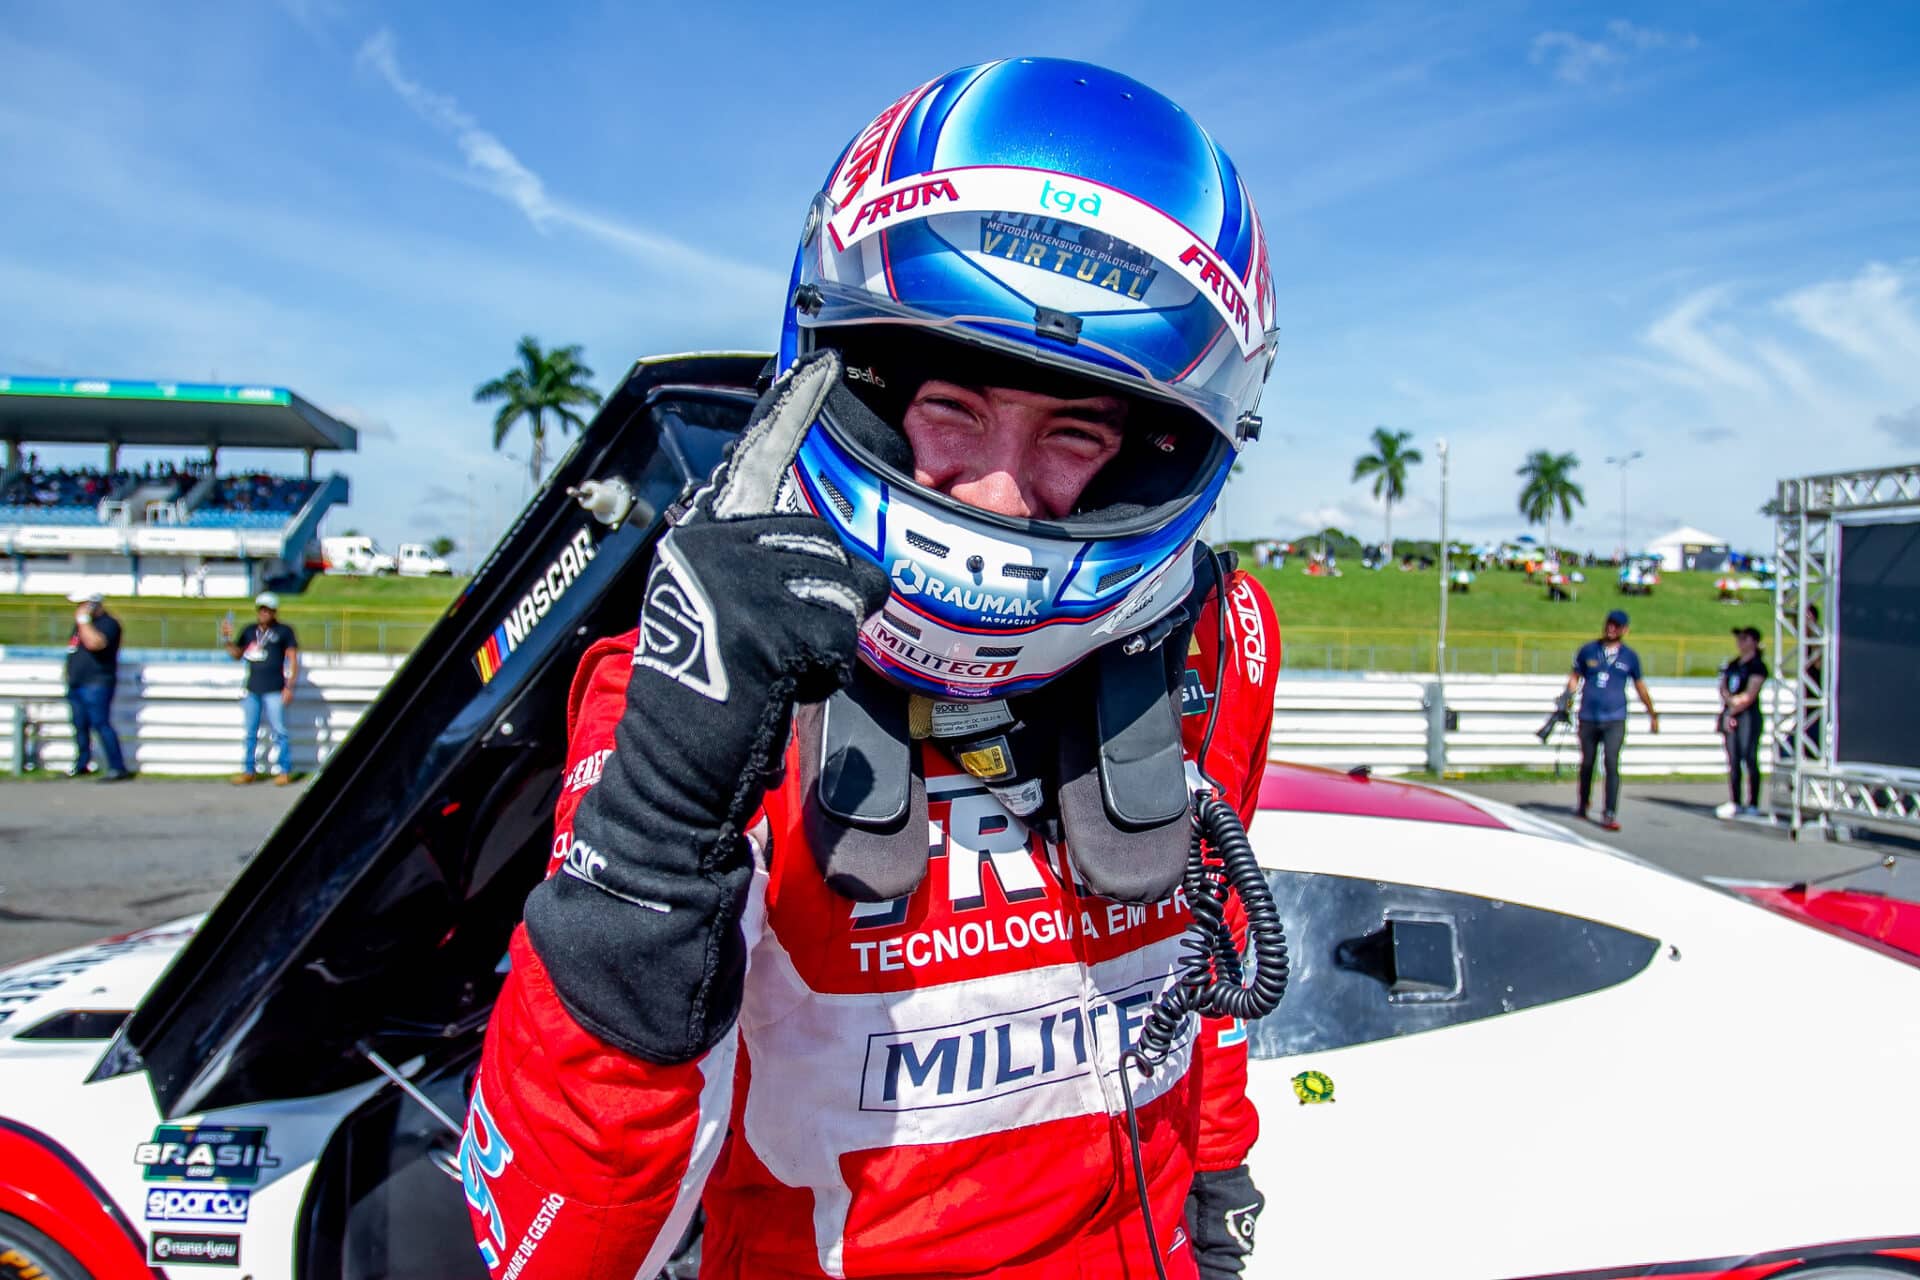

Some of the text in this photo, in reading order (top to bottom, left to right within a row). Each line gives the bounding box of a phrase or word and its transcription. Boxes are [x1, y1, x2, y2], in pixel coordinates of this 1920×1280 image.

[848, 178, 960, 236] FRUM
[1039, 179, 1103, 217] tga
[983, 231, 1143, 299] VIRTUAL
[1029, 231, 1082, 253] INTENSIVO
[1083, 247, 1096, 258] DE
[1098, 252, 1150, 277] PILOTAGEM
[1179, 244, 1249, 345] FRUM
[503, 526, 598, 651] NASCAR
[925, 578, 1043, 616] RAUMAK
[1232, 579, 1268, 688] sparc
[1181, 684, 1215, 703] SIL
[850, 909, 1099, 973] TECNOLOGIA
[1106, 902, 1147, 936] EM
[135, 1142, 280, 1168] BRASIL
[148, 1190, 248, 1219] sparco
[527, 1193, 565, 1241] GESTÃO
[518, 1235, 538, 1258] DE
